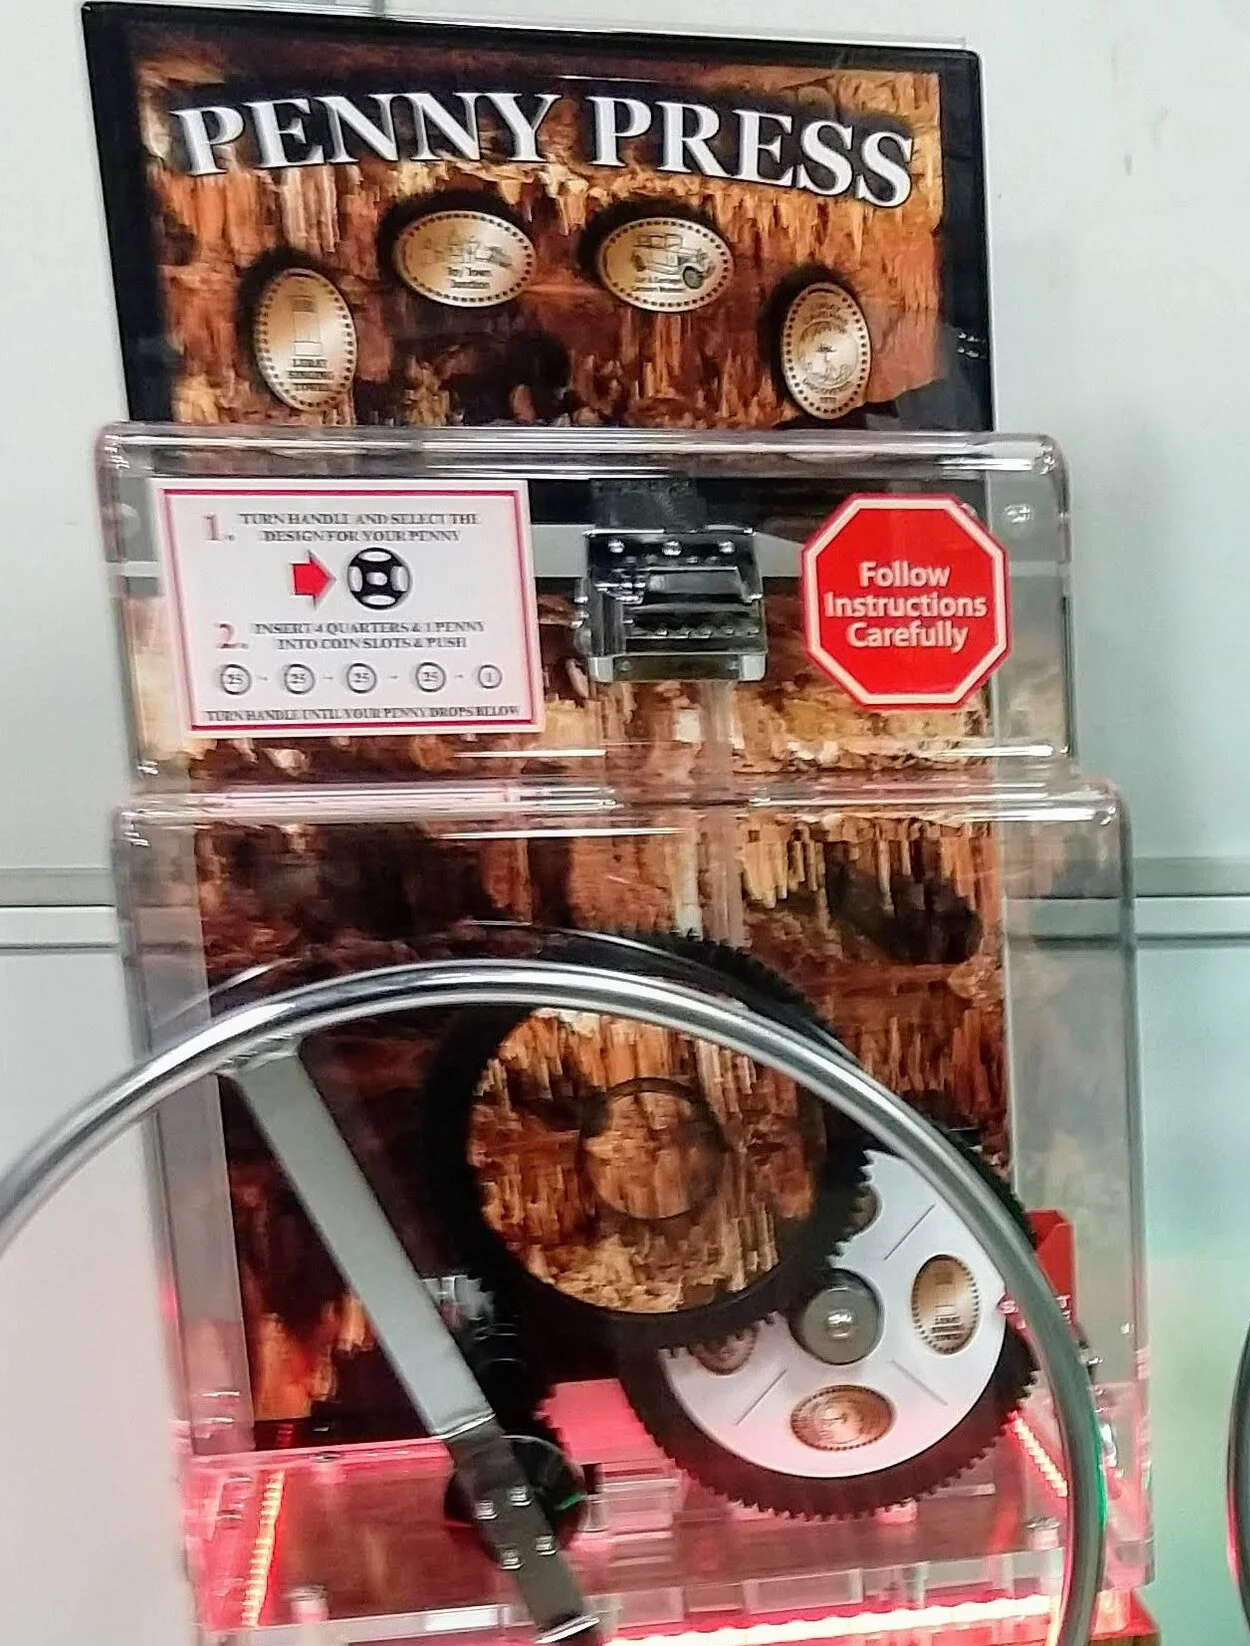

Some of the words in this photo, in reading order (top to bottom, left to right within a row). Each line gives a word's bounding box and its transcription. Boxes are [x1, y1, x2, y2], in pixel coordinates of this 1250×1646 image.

[169, 92, 562, 176] PENNY
[585, 95, 913, 208] PRESS
[238, 513, 285, 525] TURN
[287, 513, 349, 525] HANDLE
[356, 513, 388, 525] AND
[390, 513, 445, 525] SELECT
[449, 513, 479, 525] THE
[262, 530, 324, 542] DESIGN
[326, 530, 359, 542] FOR
[361, 530, 405, 542] YOUR
[407, 530, 460, 542] PENNY
[859, 560, 950, 588] Follow
[823, 592, 987, 618] Instructions
[254, 622, 311, 634] INSERT
[314, 622, 322, 634] 4
[326, 621, 409, 635] QUARTERS
[412, 621, 421, 632] &
[425, 621, 433, 632] 1
[434, 621, 485, 632] PENNY
[278, 638, 318, 650] INTO
[321, 638, 360, 650] COIN
[362, 637, 410, 649] SLOTS
[413, 637, 423, 648] &
[426, 637, 468, 648] PUSH
[846, 620, 969, 654] Carefully
[206, 710, 243, 721] TURN
[246, 710, 298, 720] HANDLE
[302, 709, 343, 720] UNTIL
[345, 708, 381, 719] YOUR
[384, 708, 426, 719] PENNY
[429, 707, 474, 718] DROPS
[476, 706, 519, 717] BELOW
